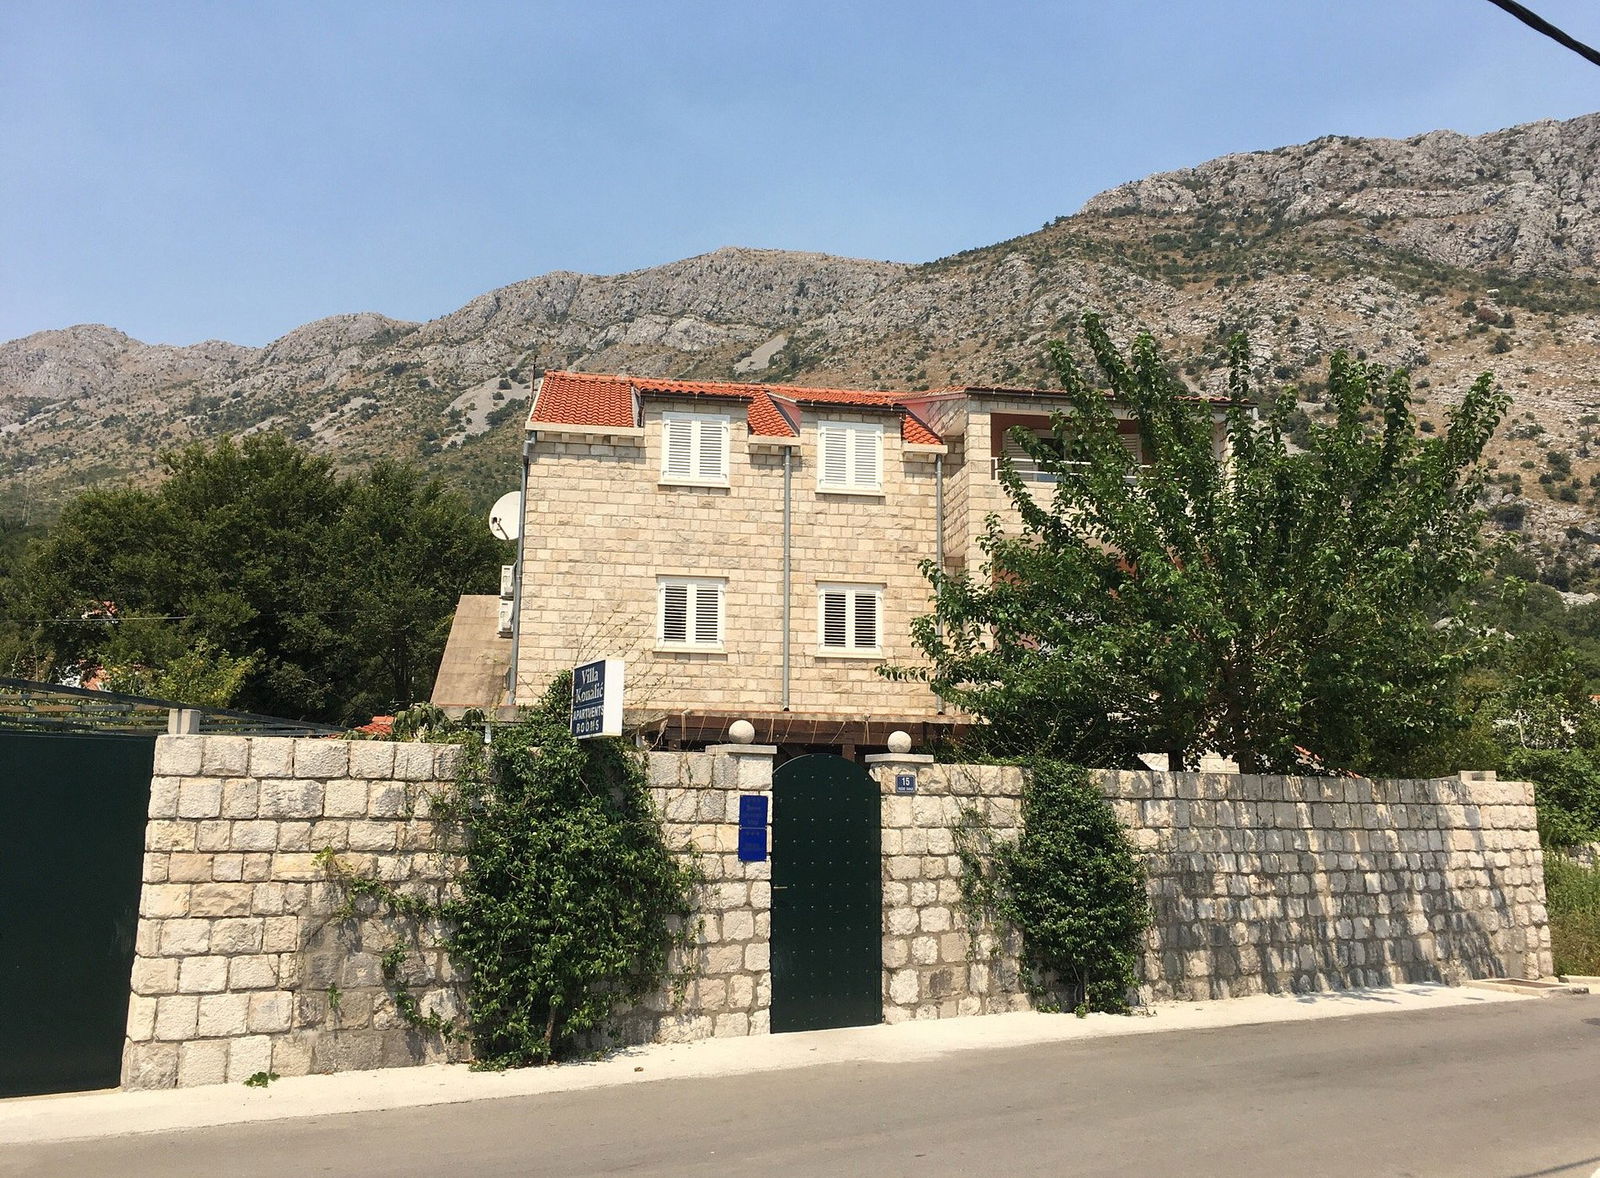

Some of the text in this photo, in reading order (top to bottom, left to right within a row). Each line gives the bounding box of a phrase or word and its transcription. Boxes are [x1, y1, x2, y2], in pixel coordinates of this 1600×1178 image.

[582, 667, 599, 684] Villa
[573, 705, 604, 721] APARTMENTS
[576, 720, 600, 733] ROOMS
[902, 777, 910, 786] 15
